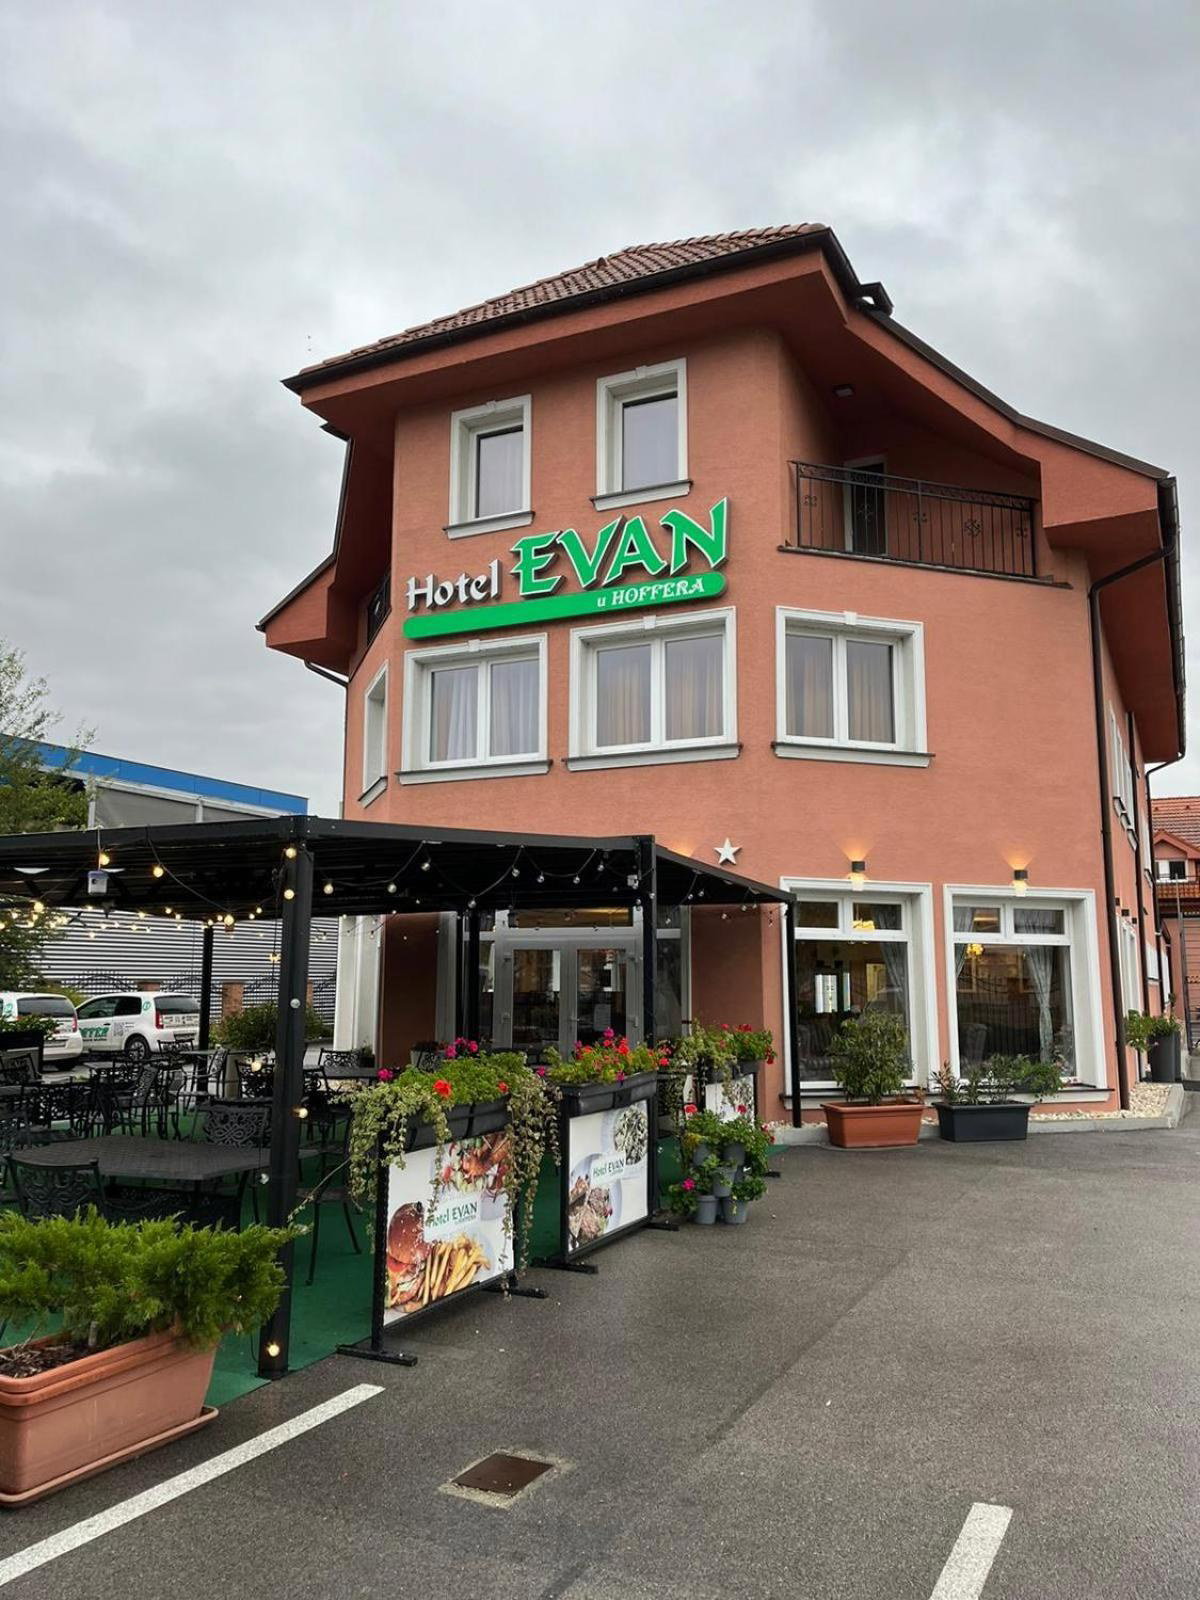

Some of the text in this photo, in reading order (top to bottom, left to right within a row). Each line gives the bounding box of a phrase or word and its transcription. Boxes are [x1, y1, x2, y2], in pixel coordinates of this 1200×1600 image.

[405, 496, 728, 611] Hotel EVAN
[597, 578, 705, 607] u HOFFERA
[452, 1201, 478, 1220] EVAN
